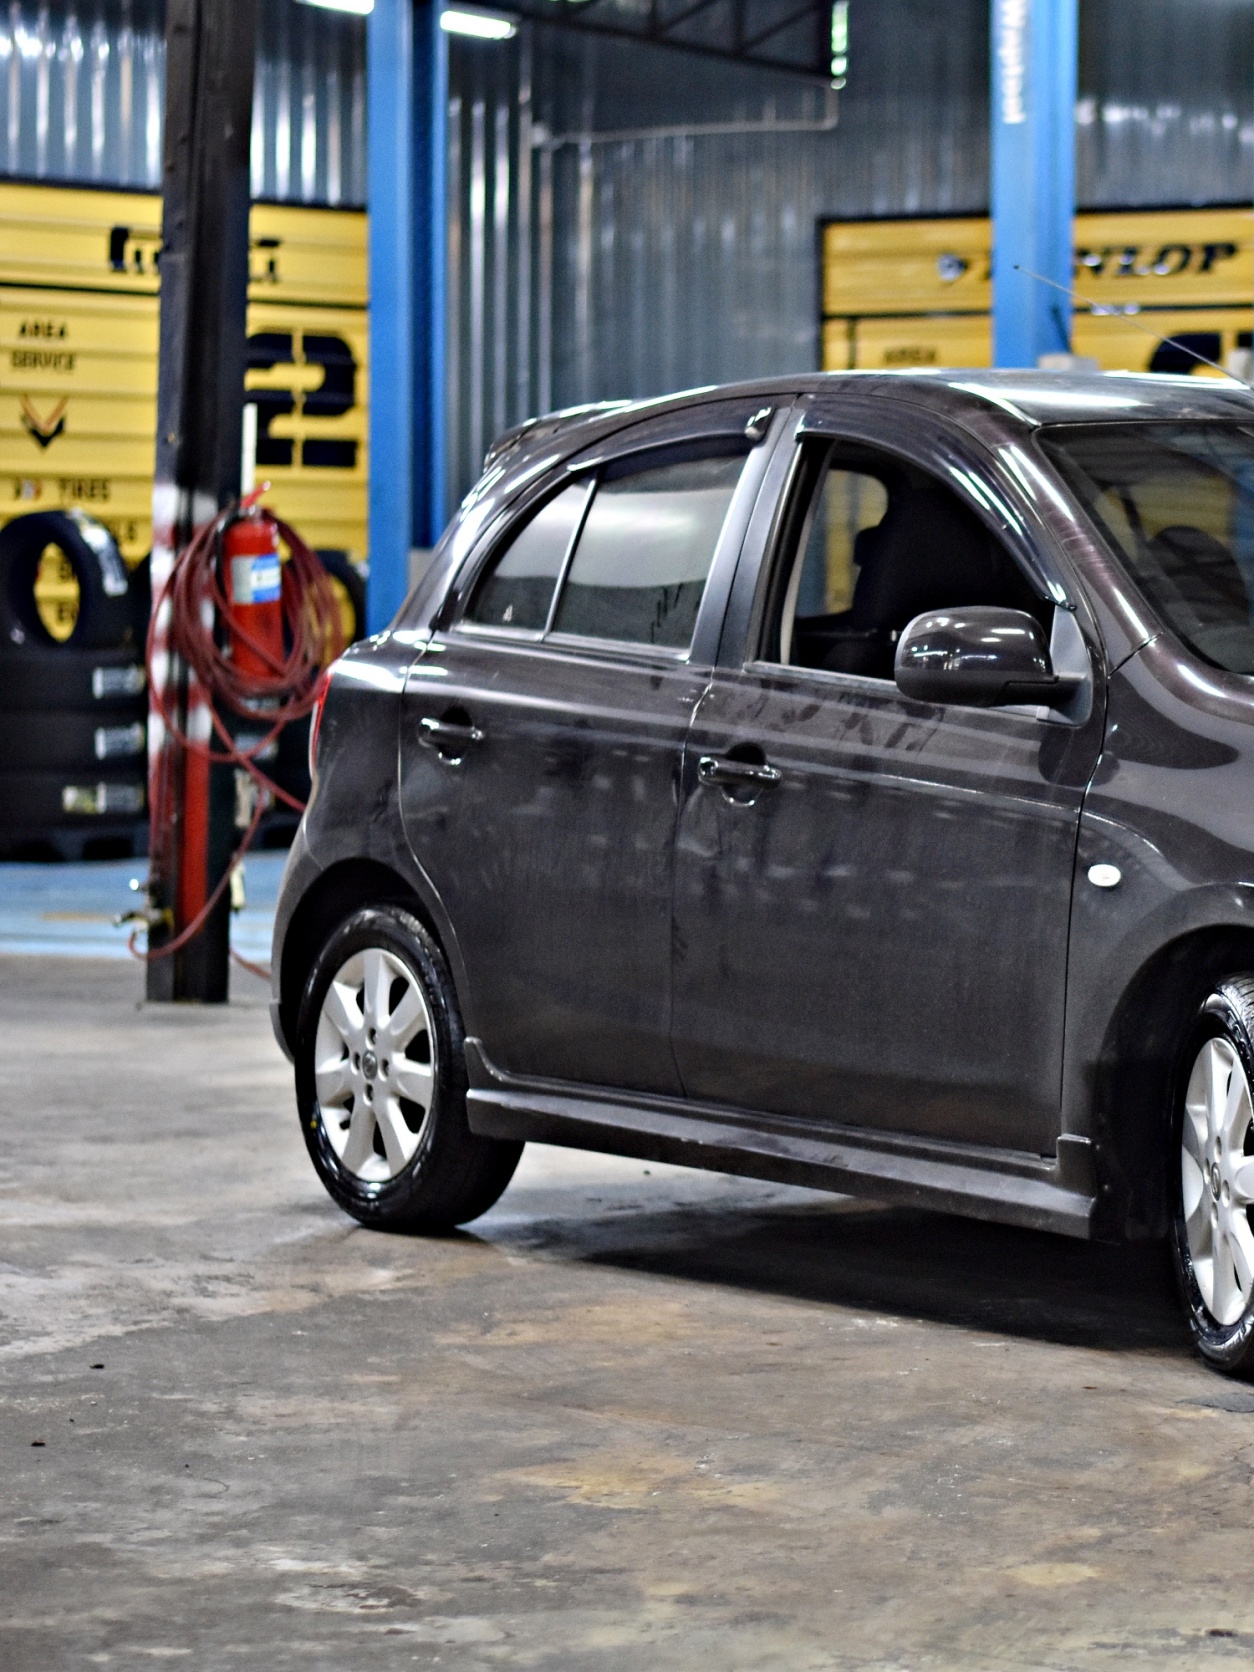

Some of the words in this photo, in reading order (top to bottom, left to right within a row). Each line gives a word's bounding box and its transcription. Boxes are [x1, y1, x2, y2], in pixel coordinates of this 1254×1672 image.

[983, 241, 1237, 280] NLOP
[18, 321, 67, 340] AREA
[11, 352, 76, 375] SERVICE
[58, 479, 111, 501] TIRES
